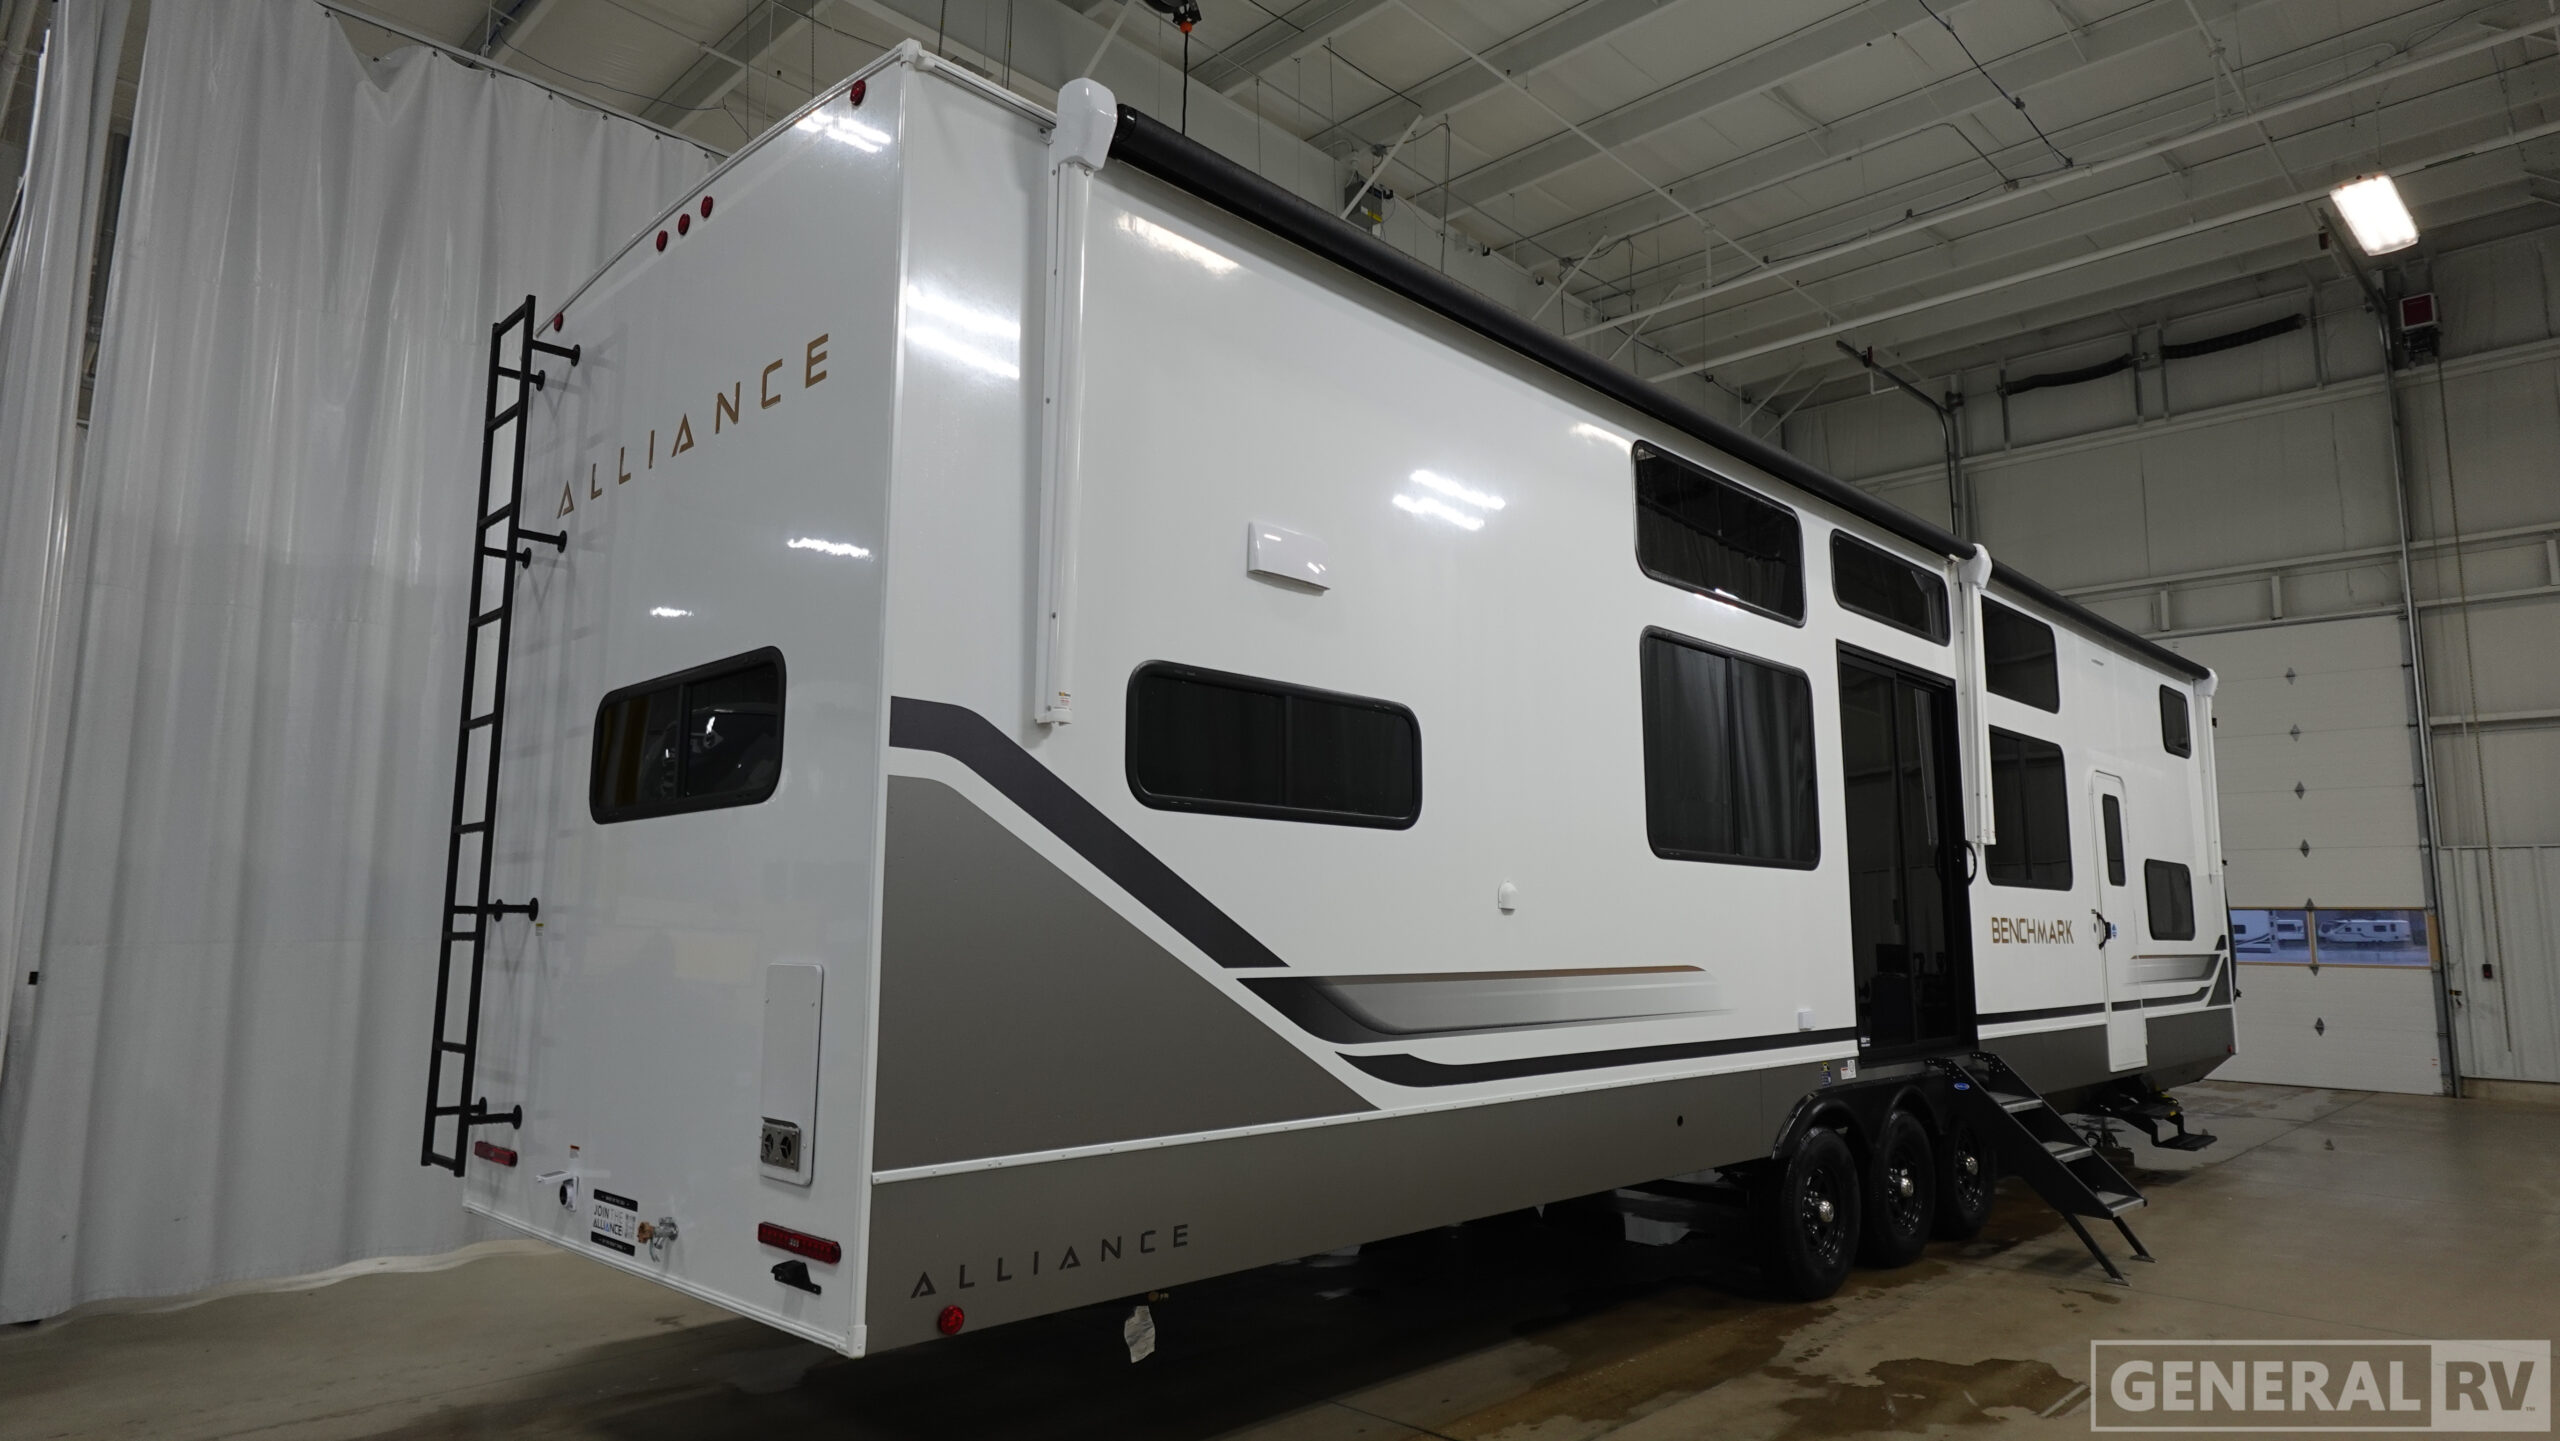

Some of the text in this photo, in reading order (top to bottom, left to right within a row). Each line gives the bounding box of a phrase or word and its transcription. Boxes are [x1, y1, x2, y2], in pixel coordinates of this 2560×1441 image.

[556, 333, 829, 519] ALLIANCE
[1991, 917, 2075, 944] BENCHMARK
[593, 1205, 610, 1219] JOIN
[593, 1219, 623, 1236] ALLIANCE
[910, 1224, 1189, 1299] ALLIANCE
